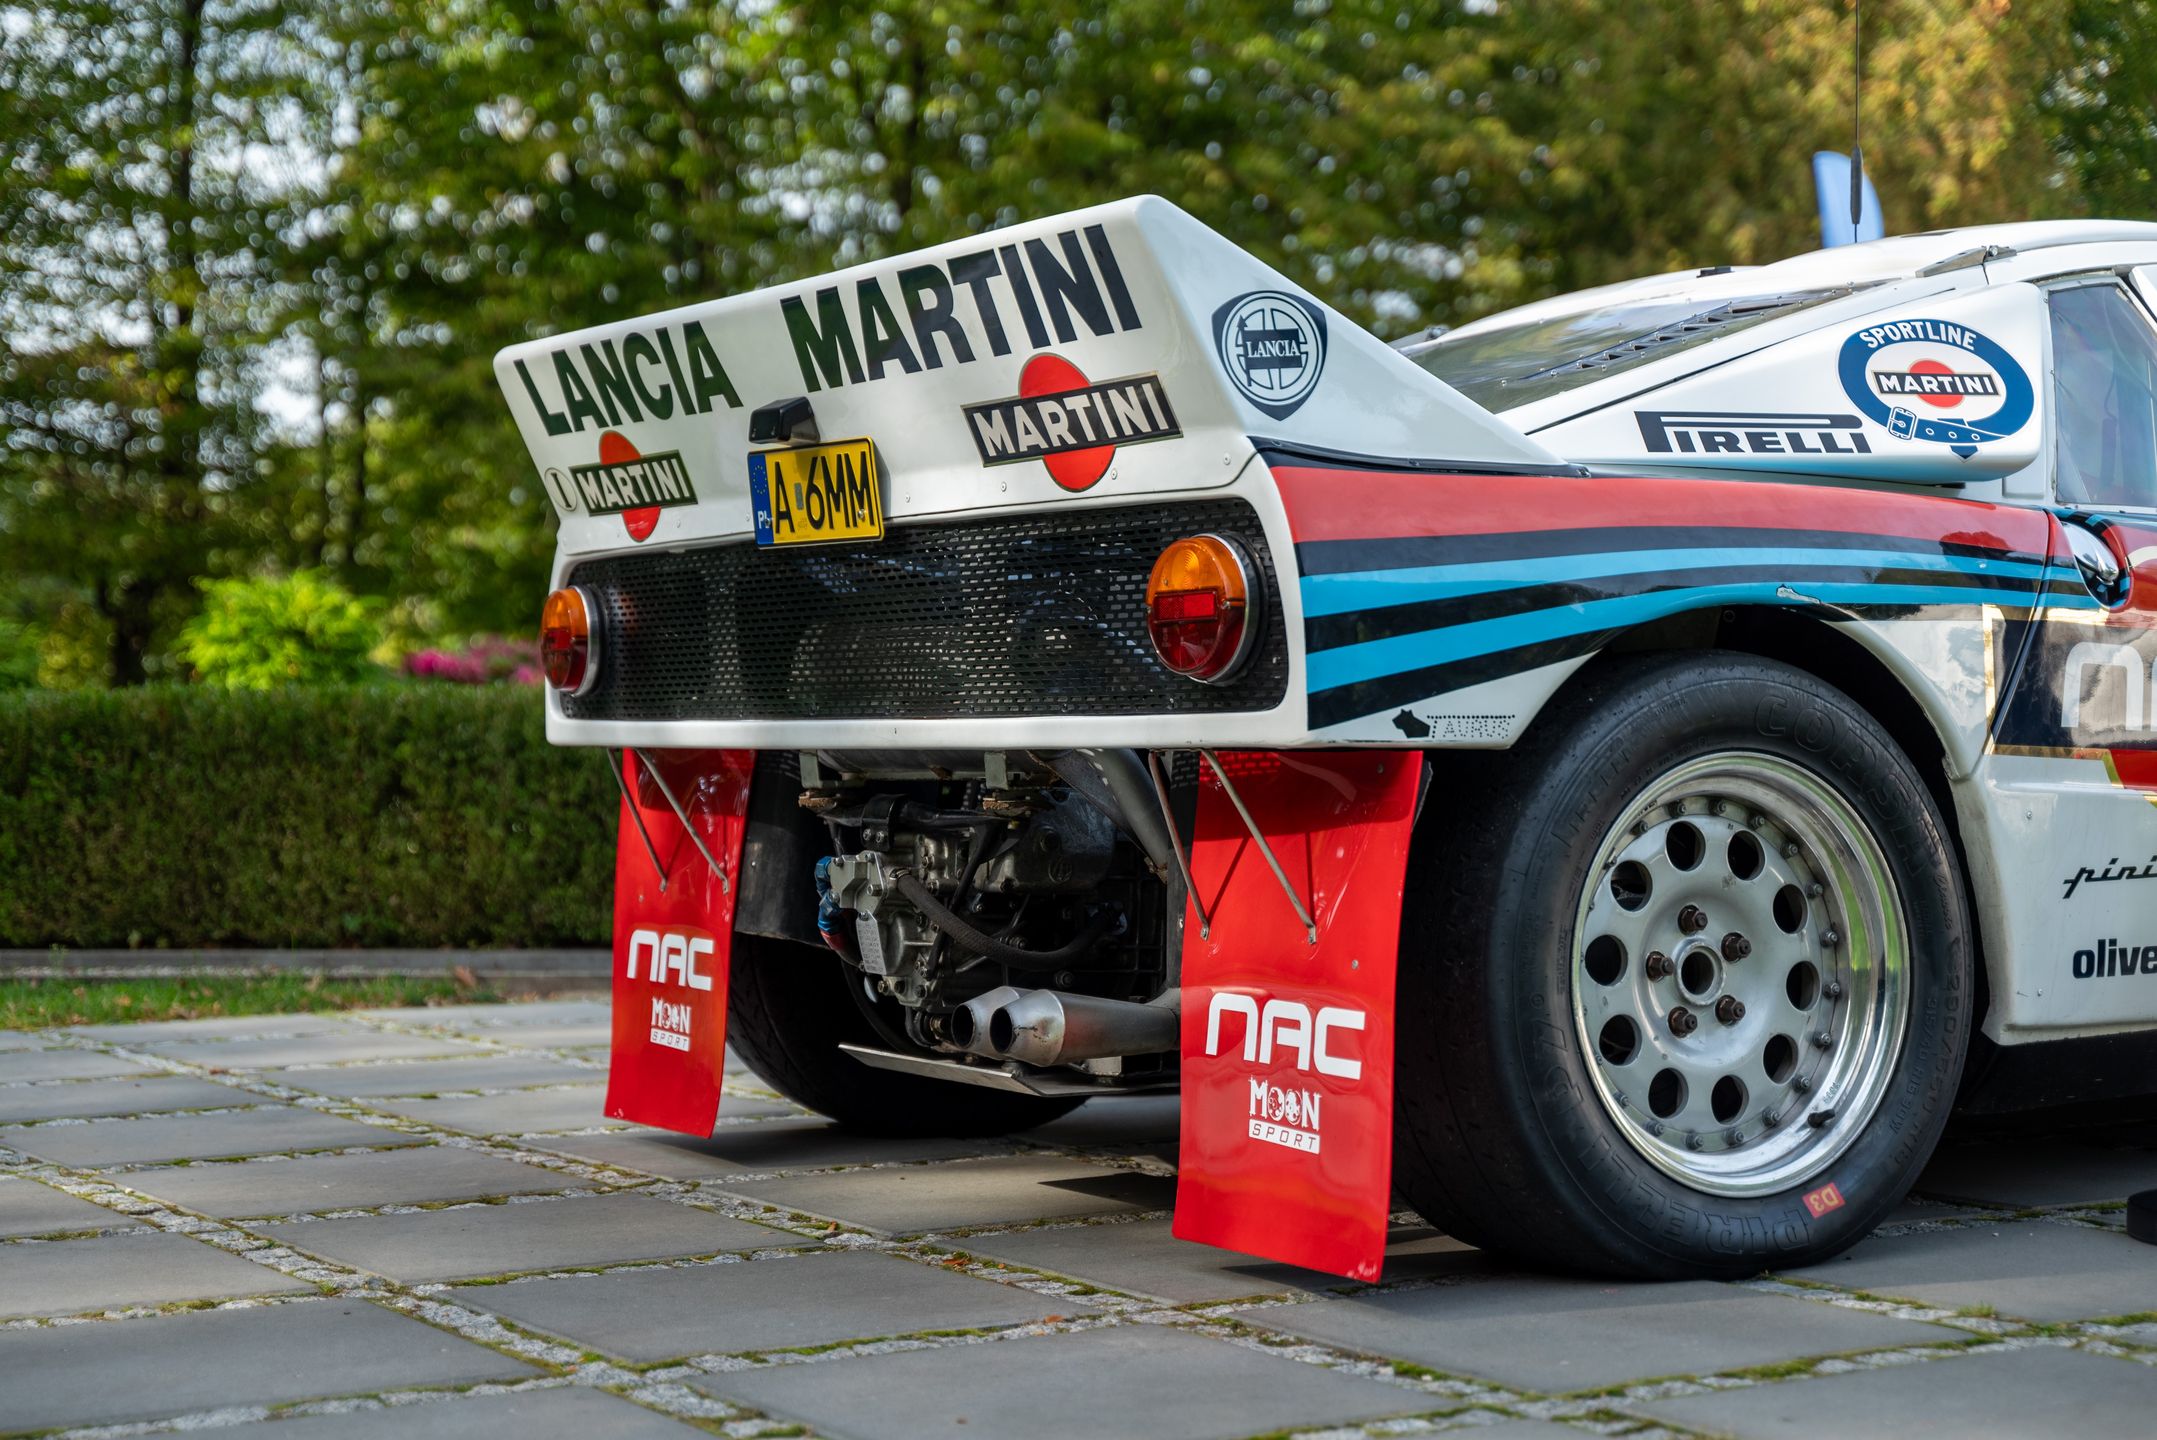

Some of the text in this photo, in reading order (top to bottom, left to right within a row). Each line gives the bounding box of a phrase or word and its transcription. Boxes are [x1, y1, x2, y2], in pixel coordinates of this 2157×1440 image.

[513, 224, 1142, 437] LANCIA MARTINI
[1246, 339, 1301, 358] LANCIA
[1858, 320, 1979, 351] SPORTLINE
[1879, 373, 1995, 395] MARTINI
[971, 382, 1169, 459] MARTINI
[1634, 411, 1873, 454] PIRELLI
[576, 458, 690, 510] MARTINI
[774, 450, 876, 534] A 6MM
[651, 996, 691, 1035] MOON
[651, 1031, 688, 1050] SPORT
[1248, 1074, 1323, 1131] MOON
[1252, 1123, 1317, 1151] SPORT
[1808, 1185, 1840, 1212] D3
